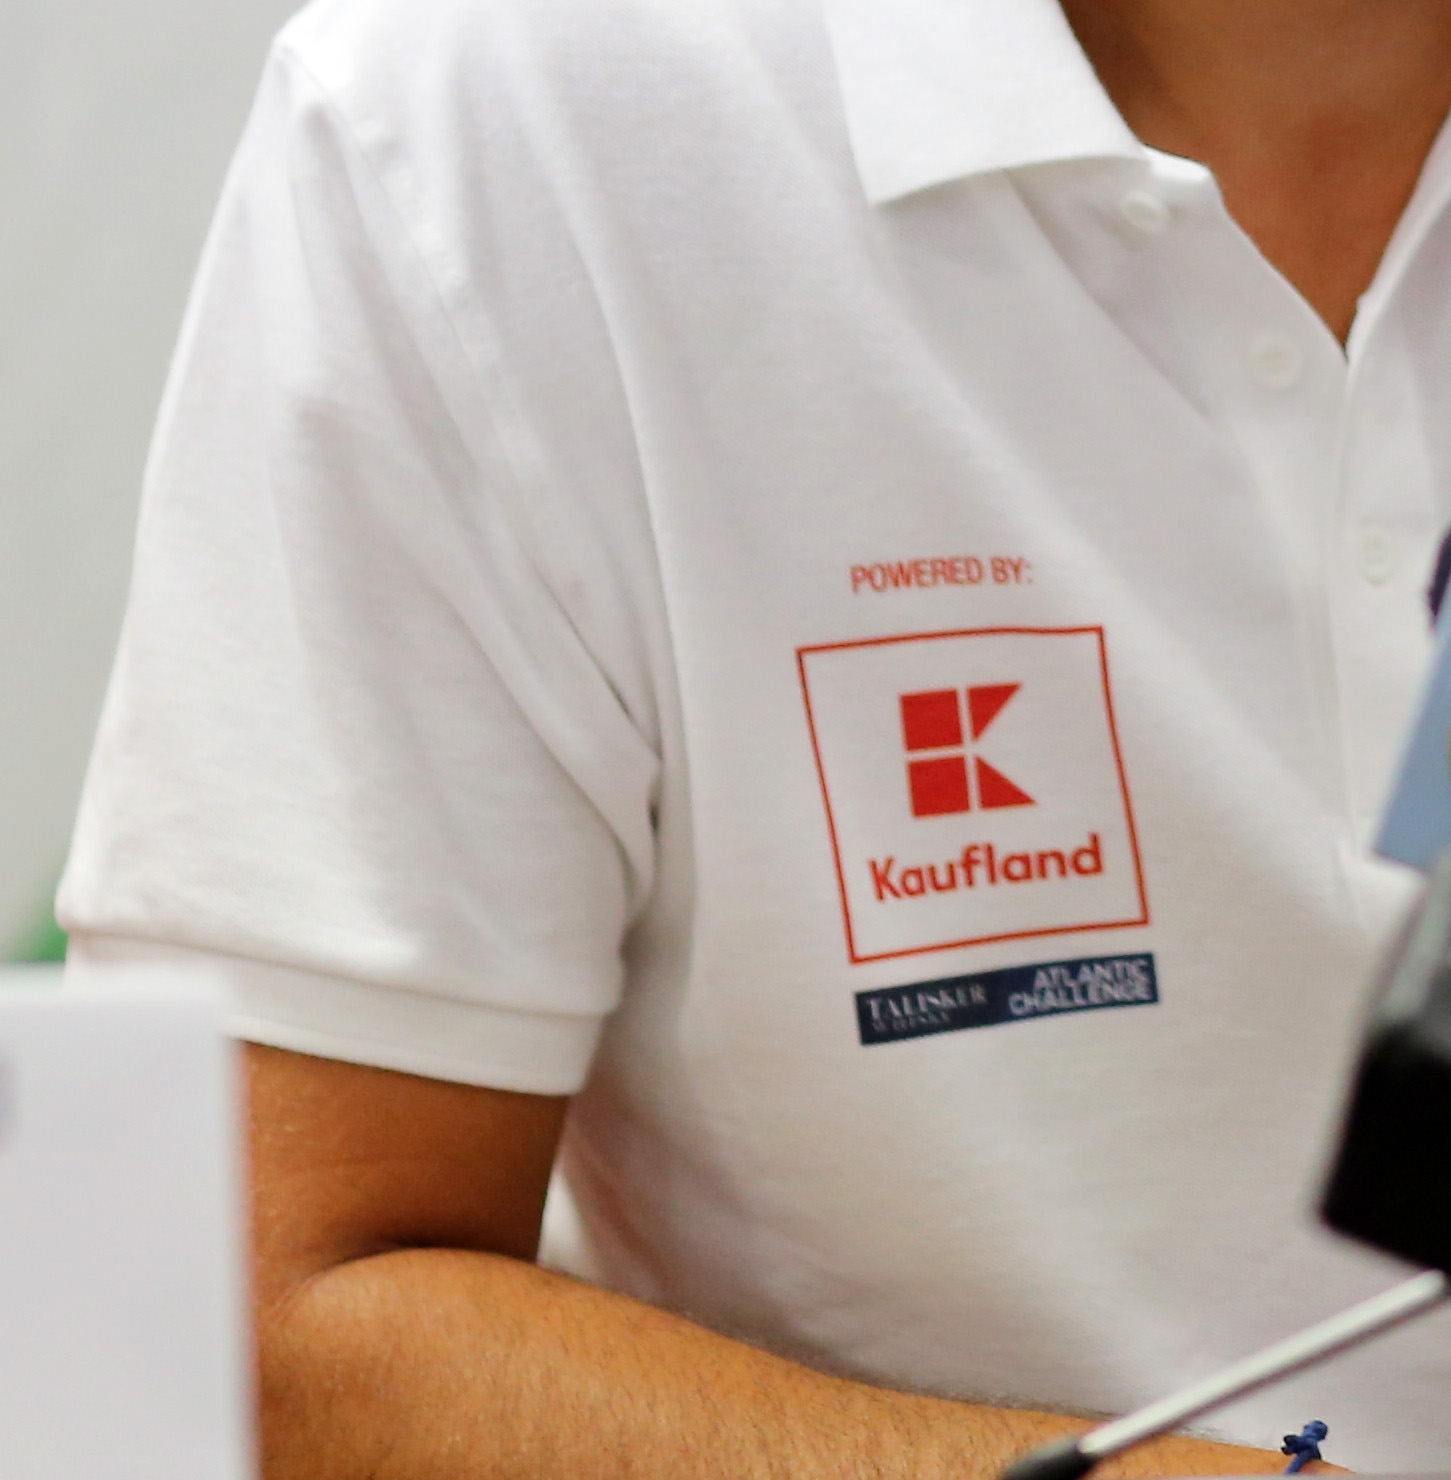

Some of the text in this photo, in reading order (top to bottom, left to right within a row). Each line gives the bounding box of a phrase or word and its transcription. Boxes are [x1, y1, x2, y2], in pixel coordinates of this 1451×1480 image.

[850, 555, 1034, 594] POWERED BY:
[869, 832, 1105, 903] Kaufland
[1032, 959, 1150, 991] ATLANTIC
[1007, 977, 1152, 1018] CHALLENGE
